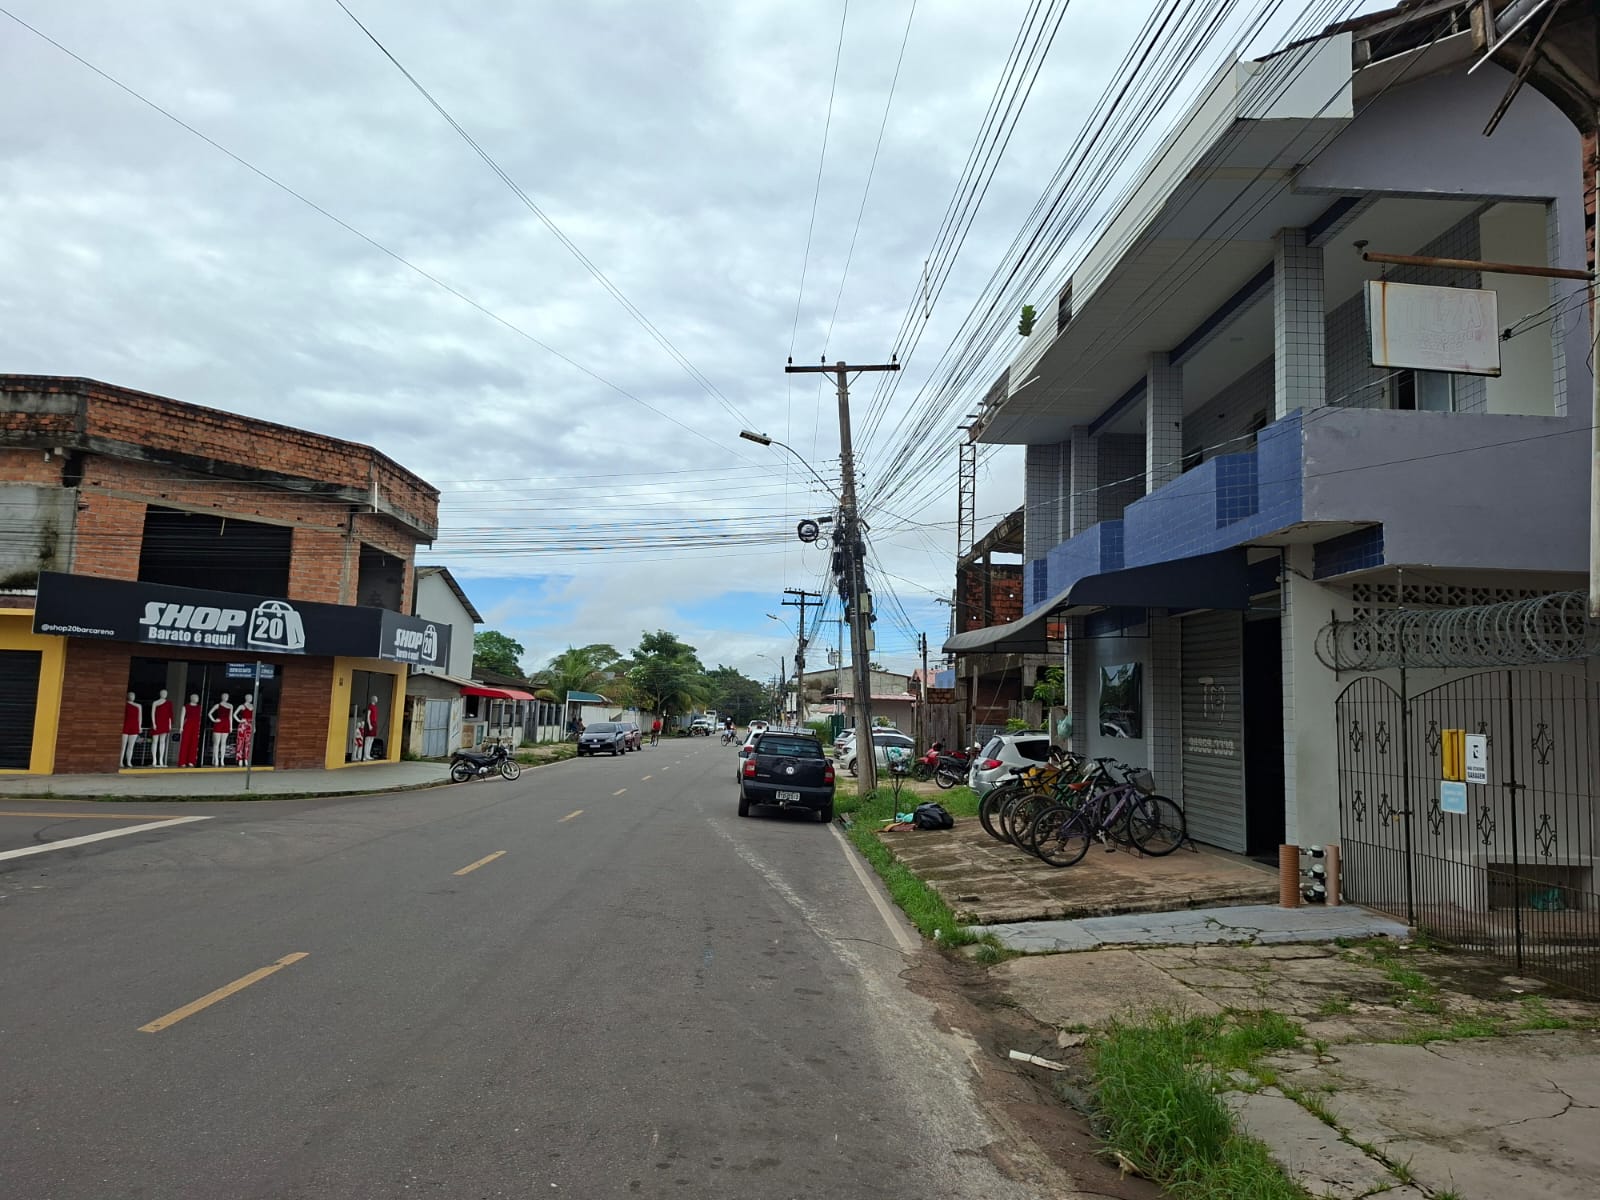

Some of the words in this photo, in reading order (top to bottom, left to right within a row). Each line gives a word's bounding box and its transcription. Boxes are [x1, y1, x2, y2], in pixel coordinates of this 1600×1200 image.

[41, 624, 115, 636] @shop20barcarena
[139, 601, 247, 632] SHOP
[255, 617, 284, 640] 20
[148, 626, 192, 642] Barato
[194, 631, 202, 643] é
[204, 633, 236, 646] aqui!
[394, 628, 424, 650] SHOP
[423, 637, 433, 654] 20
